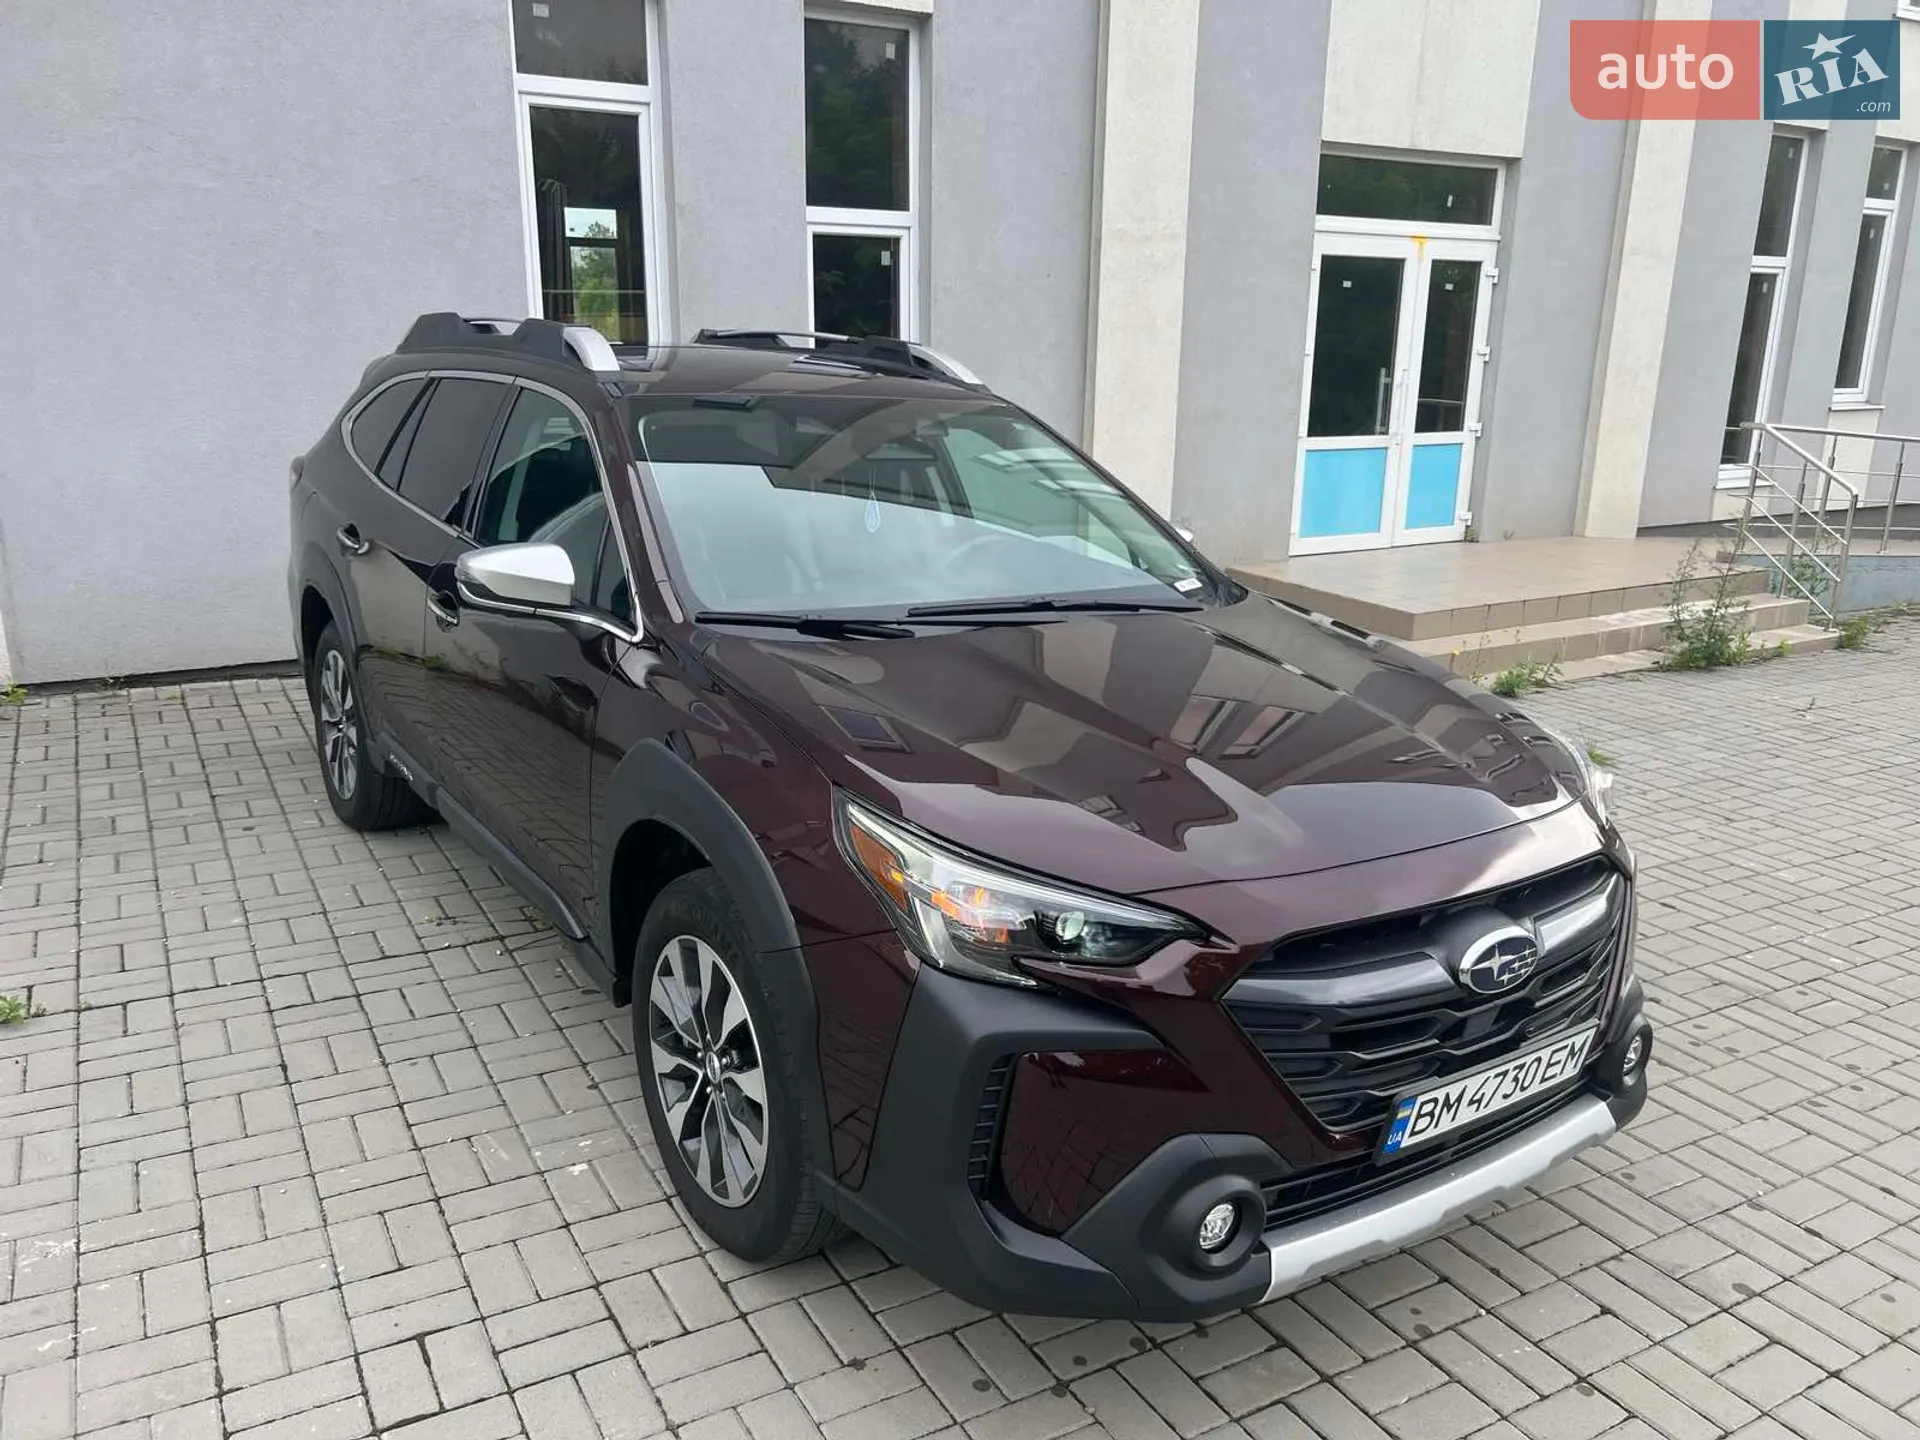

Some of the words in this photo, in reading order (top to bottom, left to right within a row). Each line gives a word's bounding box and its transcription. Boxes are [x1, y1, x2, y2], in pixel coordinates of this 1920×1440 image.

[1408, 1085, 1468, 1138] BM
[1467, 1056, 1542, 1112] 4730
[1539, 1035, 1590, 1085] EM
[1387, 1131, 1402, 1145] UA
